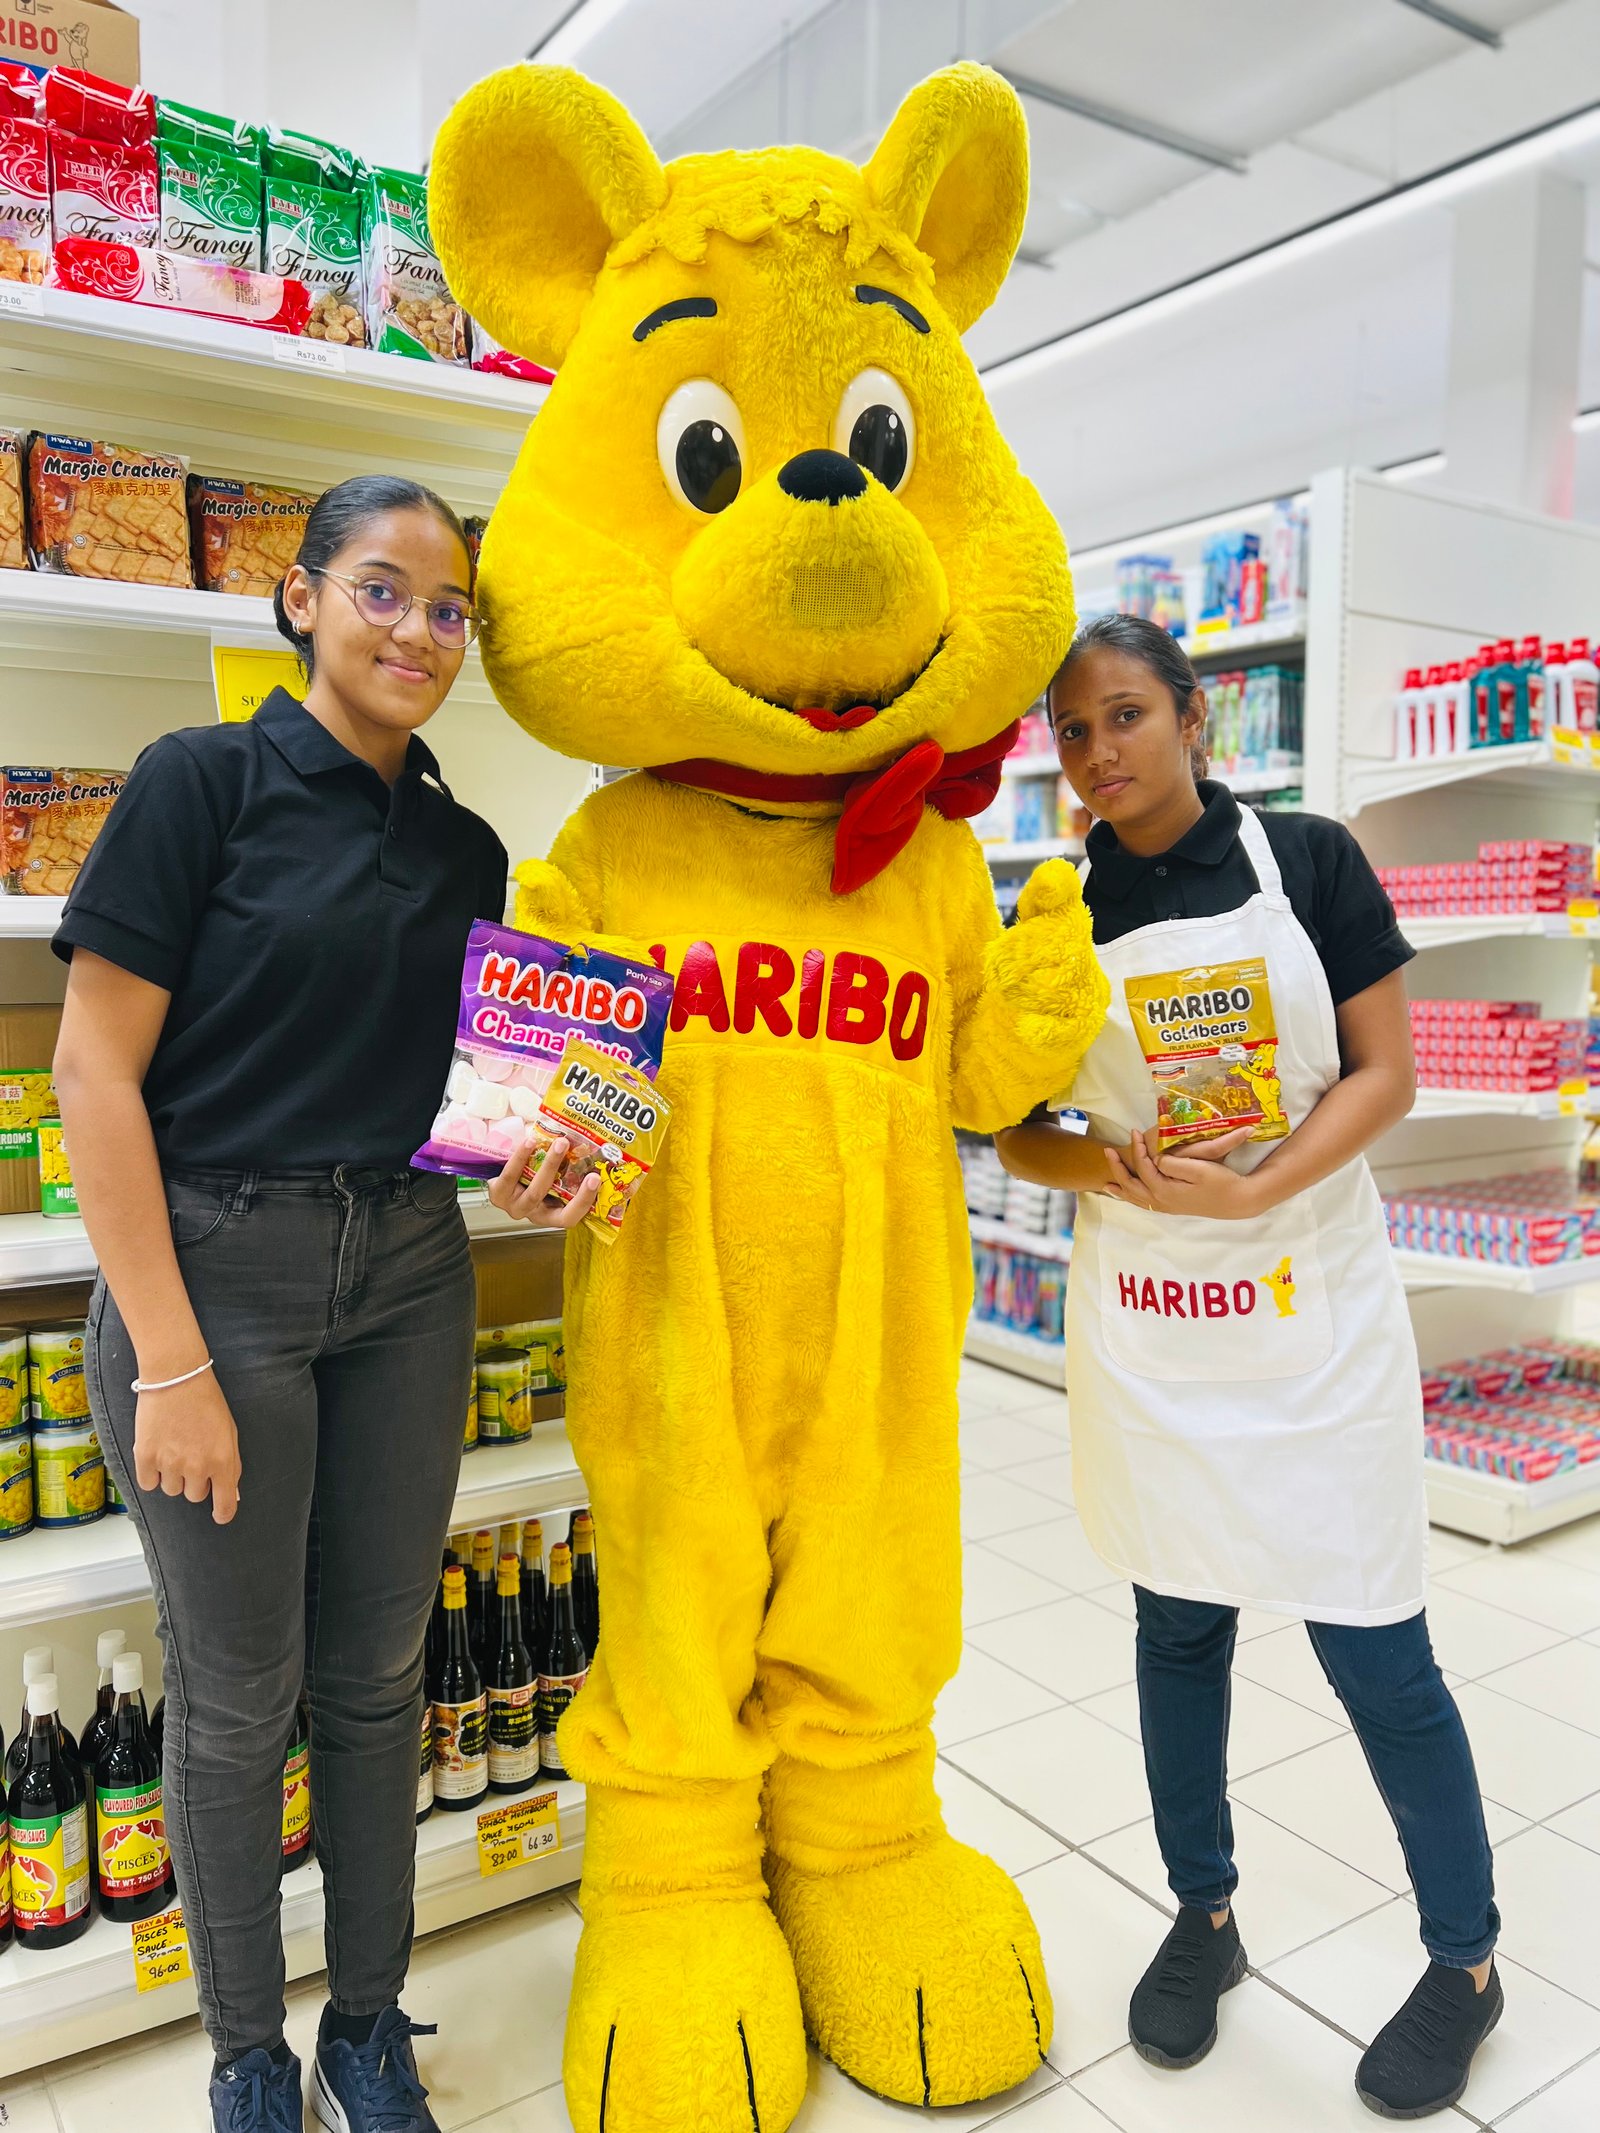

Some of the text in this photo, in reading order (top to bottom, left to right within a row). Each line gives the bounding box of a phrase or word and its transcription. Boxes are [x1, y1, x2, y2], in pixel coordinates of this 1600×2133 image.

[271, 195, 301, 213] EVER
[164, 216, 255, 267] Fancy
[151, 252, 174, 301] Fancy
[272, 244, 357, 296] Fancy
[51, 436, 87, 448] HWA TAI
[44, 456, 108, 481] Margie
[207, 480, 226, 488] HWA
[202, 498, 258, 520] Margie
[4, 786, 66, 808] Margie
[626, 968, 664, 987] Party Size
[481, 955, 646, 1030] HARIBO
[648, 940, 930, 1061] ARIBO
[1147, 987, 1251, 1025] HARIBO
[1161, 1020, 1247, 1043] Goldbears
[1169, 1044, 1185, 1052] FRUIT
[1222, 1036, 1244, 1045] JELLIES
[564, 1063, 656, 1131] HARIBO
[561, 1108, 627, 1149] FRUIT FLAVOURED JELLIES
[565, 1095, 635, 1142] Goldbears
[1118, 1271, 1256, 1319] HARIBO
[104, 1798, 135, 1813] FLAVOURED
[506, 1792, 557, 1814] PROMOTION
[510, 1802, 549, 1820] MUSHROOM
[28, 1828, 46, 1843] SAUCE
[481, 1828, 503, 1842] SAUCE
[117, 1852, 156, 1871] PISCES
[106, 1878, 121, 1888] NET
[138, 1872, 153, 1884] 750
[135, 1926, 168, 1945] PISCES
[136, 1919, 154, 1931] WAY
